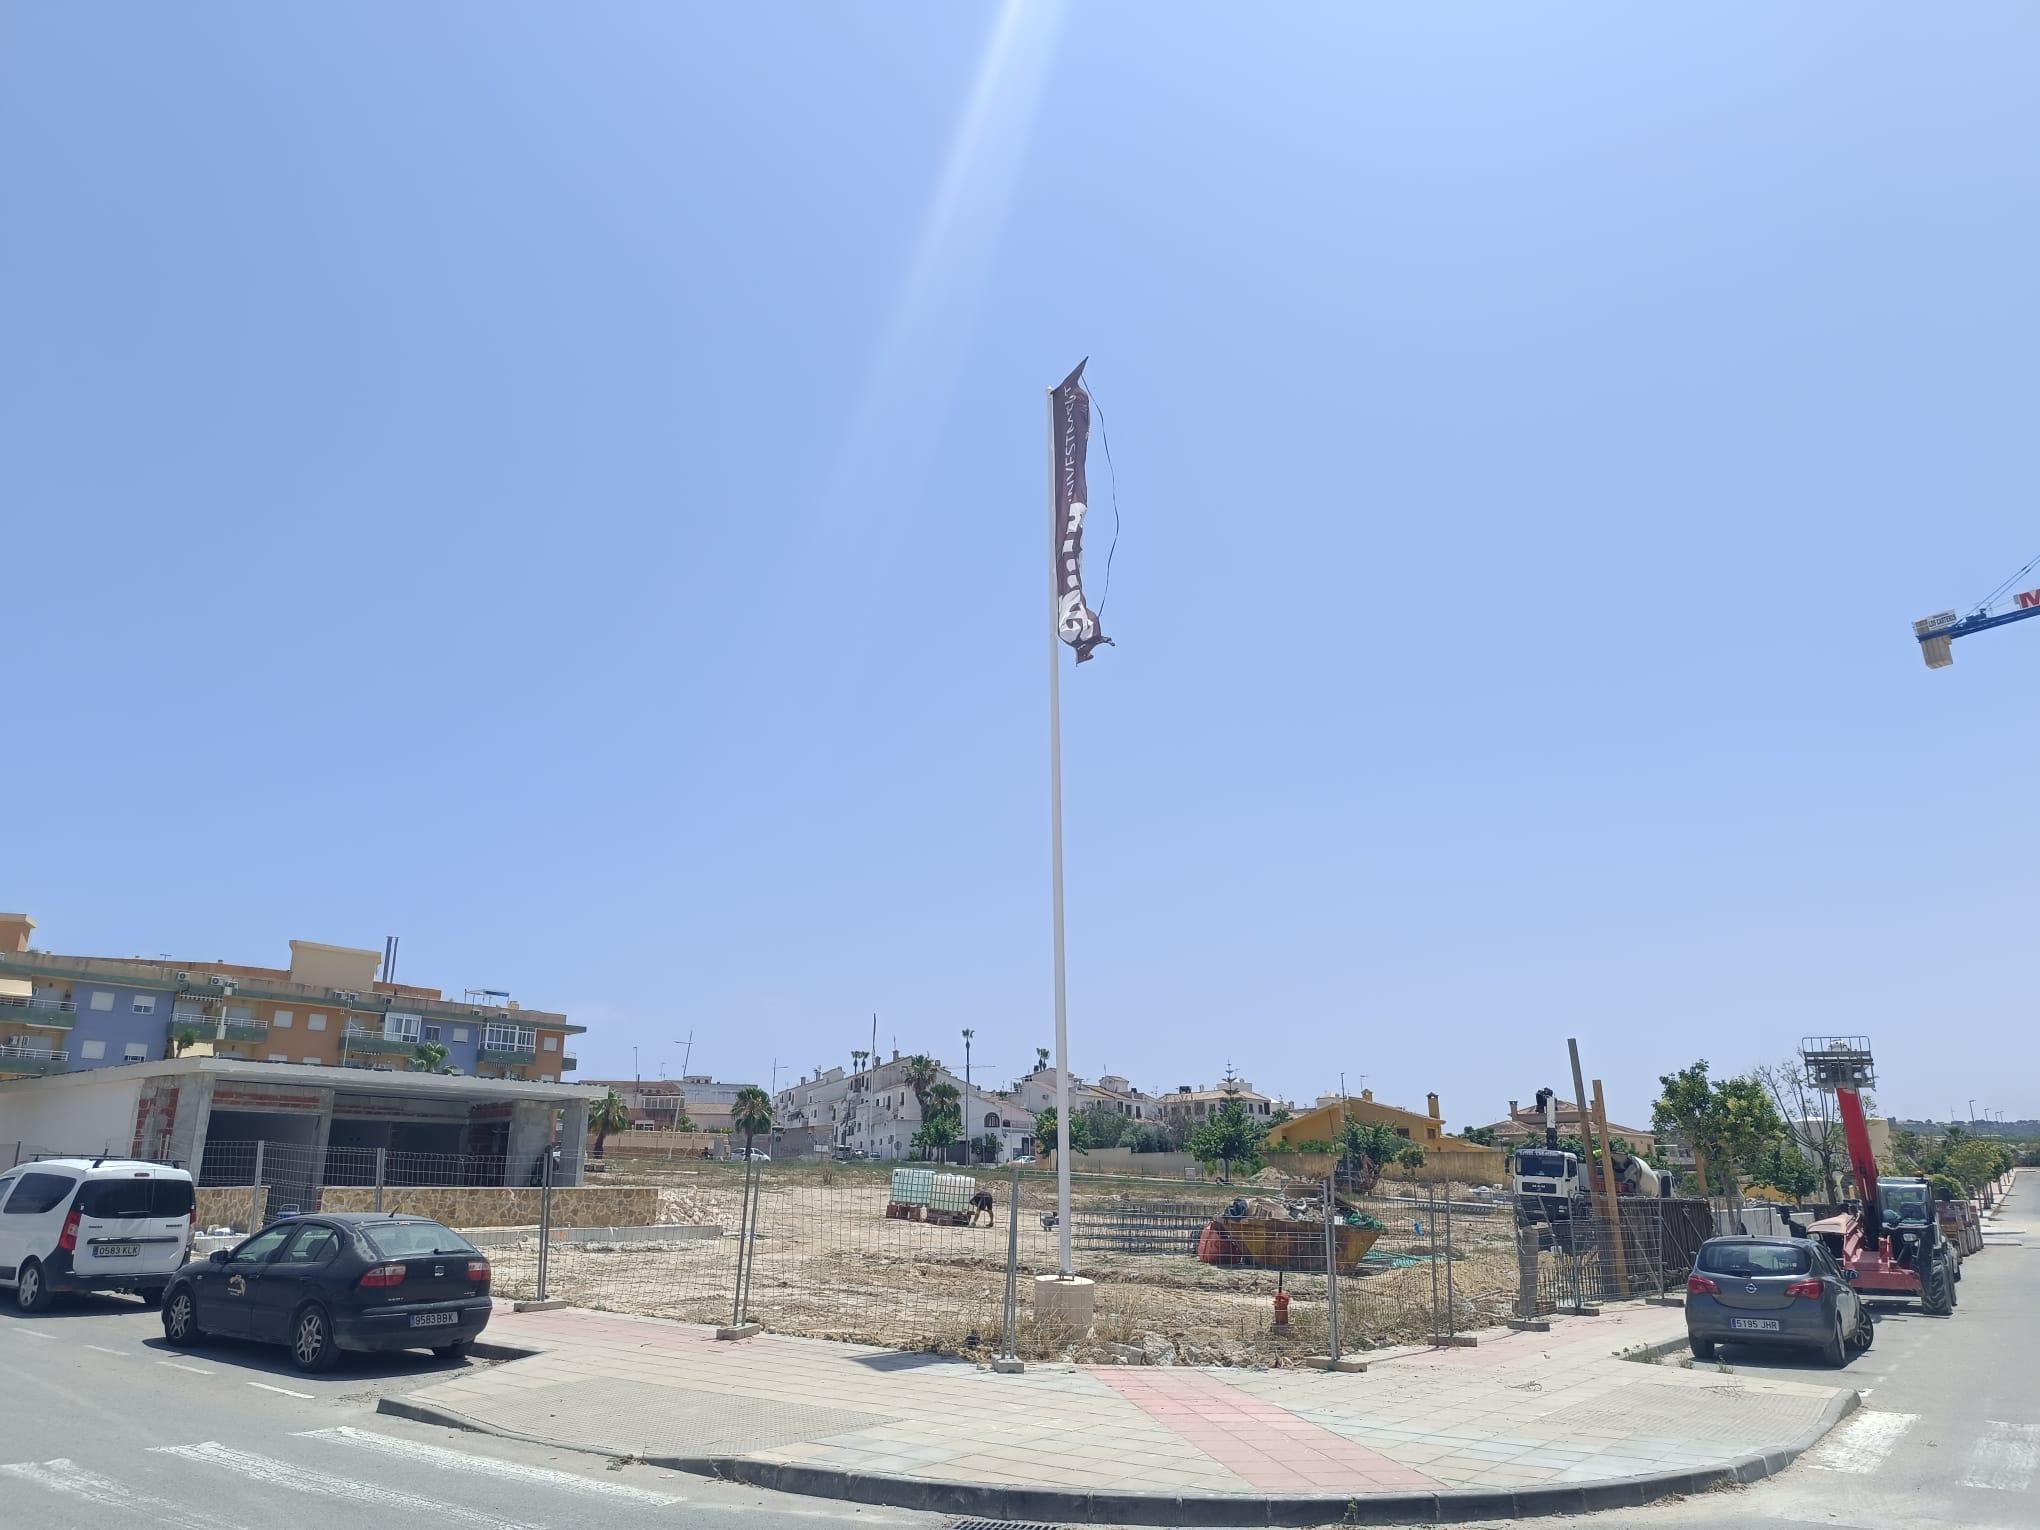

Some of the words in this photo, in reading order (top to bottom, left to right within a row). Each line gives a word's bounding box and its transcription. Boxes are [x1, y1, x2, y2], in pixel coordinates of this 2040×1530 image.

[1063, 385, 1077, 503] NVESTMENT
[99, 1247, 121, 1255] 0583
[122, 1246, 138, 1255] KLK
[1736, 1319, 1758, 1328] 5195
[1760, 1321, 1778, 1329] JHR
